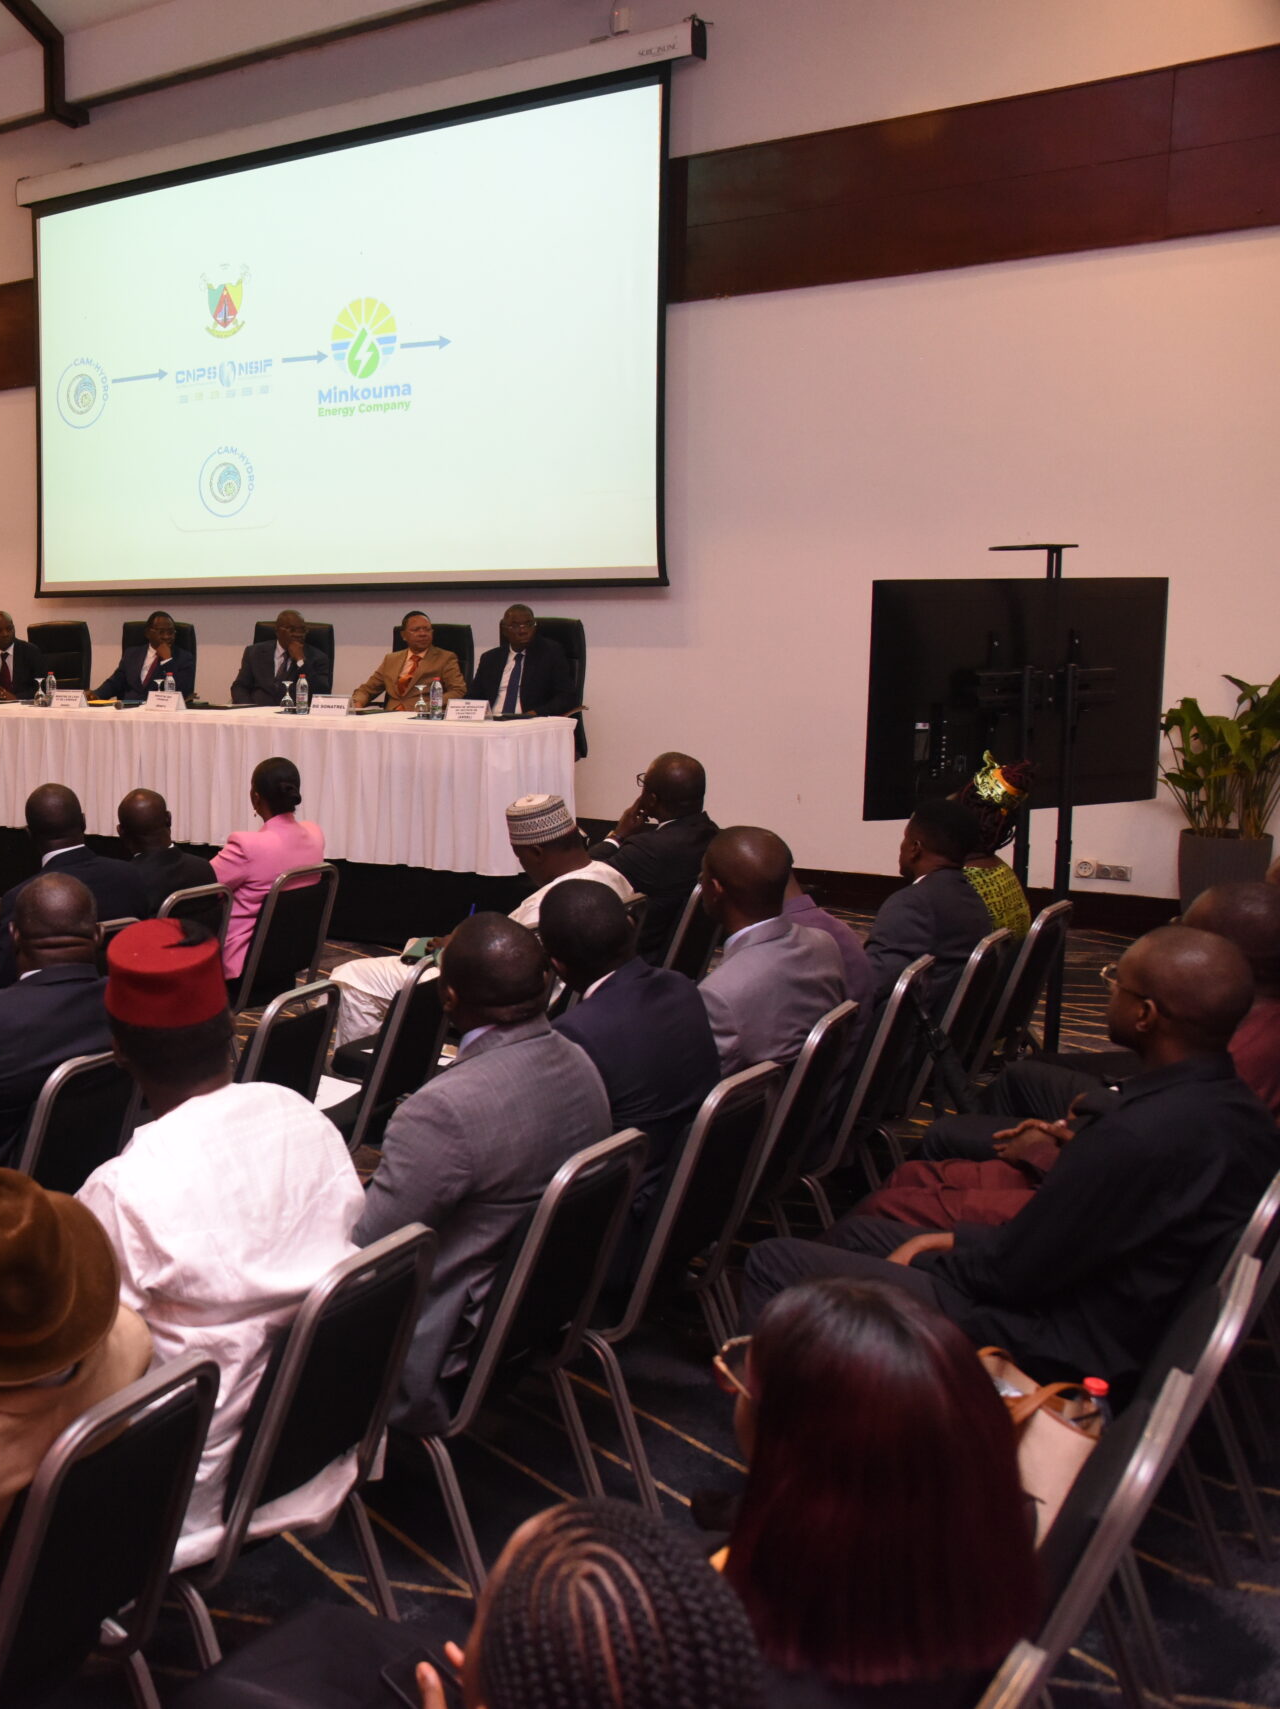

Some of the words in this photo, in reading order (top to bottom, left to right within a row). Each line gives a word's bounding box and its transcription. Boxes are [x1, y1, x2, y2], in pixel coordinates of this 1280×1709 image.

[73, 357, 109, 402] CAM-HYDRO
[175, 366, 217, 384] CNPS
[238, 358, 273, 376] NSIF
[317, 383, 412, 404] Minkouma
[317, 406, 356, 417] Energy
[358, 400, 411, 413] Company
[217, 446, 255, 491] CAM-HYDRO
